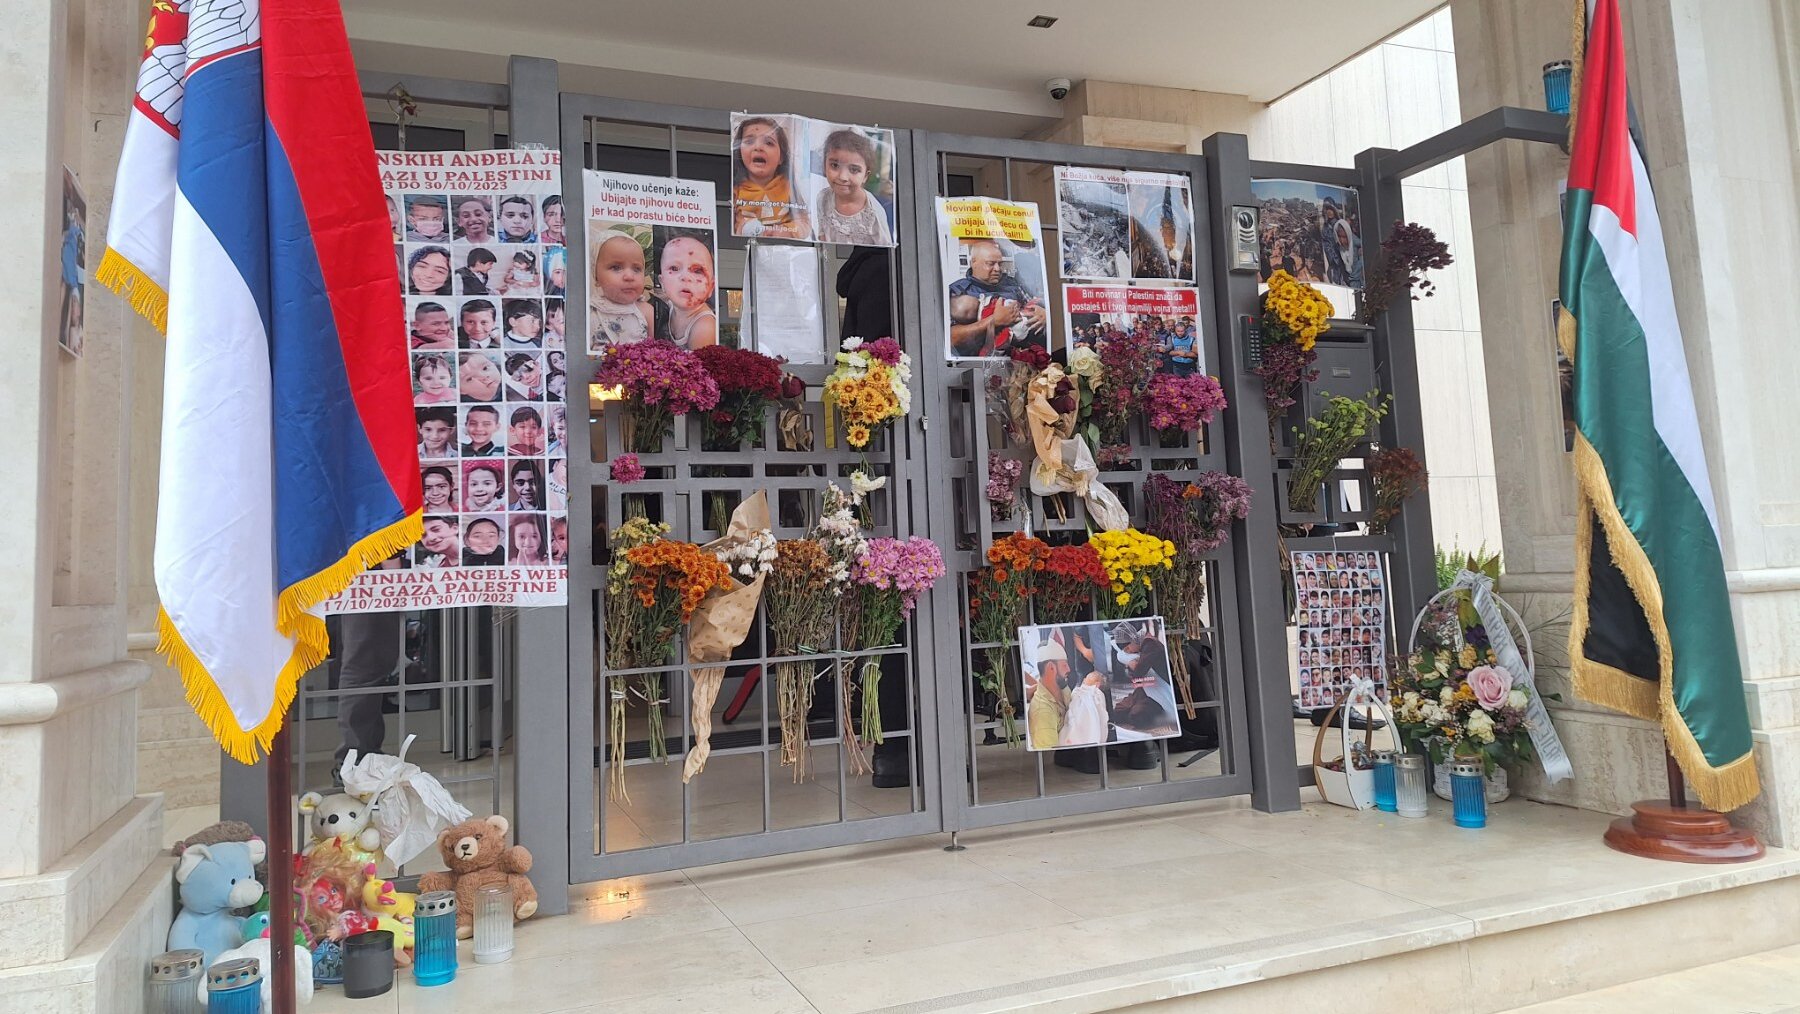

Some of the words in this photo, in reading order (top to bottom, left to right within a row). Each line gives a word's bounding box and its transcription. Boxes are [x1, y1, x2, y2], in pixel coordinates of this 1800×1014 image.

[450, 152, 535, 166] ANĐELA
[423, 171, 438, 181] U
[445, 169, 552, 181] PALESTINI
[398, 181, 421, 190] DO
[425, 181, 508, 190] 30/10/2023
[602, 178, 640, 192] Njihovo
[641, 182, 673, 196] učenje
[675, 186, 700, 197] kaže:
[600, 192, 637, 206] Ubijajte
[639, 197, 674, 208] njihovu
[677, 200, 702, 212] decu,
[736, 199, 747, 207] My
[591, 205, 605, 217] jer
[607, 206, 625, 217] kad
[627, 210, 663, 221] porastu
[666, 212, 685, 223] biće
[688, 215, 712, 225] borci
[946, 204, 983, 213] Novinari
[1013, 209, 1035, 218] cenu!
[955, 217, 985, 228] Ubijaju
[987, 218, 998, 226] im
[999, 220, 1017, 229] decu
[1018, 222, 1028, 230] da
[965, 228, 973, 236] bi
[975, 228, 984, 236] ih
[1082, 289, 1094, 299] Biti
[1095, 290, 1121, 299] novinar
[1122, 291, 1127, 299] u
[1128, 290, 1155, 300] Palestini
[1173, 291, 1183, 301] da
[1071, 301, 1101, 313] postaješ
[1101, 302, 1107, 311] ti
[350, 572, 434, 586] TINIAN
[440, 569, 521, 582] ANGELS
[350, 587, 374, 598] IN
[380, 583, 439, 597] GAZA
[445, 580, 557, 594] PALESTINE
[411, 596, 432, 607] TO
[436, 593, 514, 606] 30/10/2023
